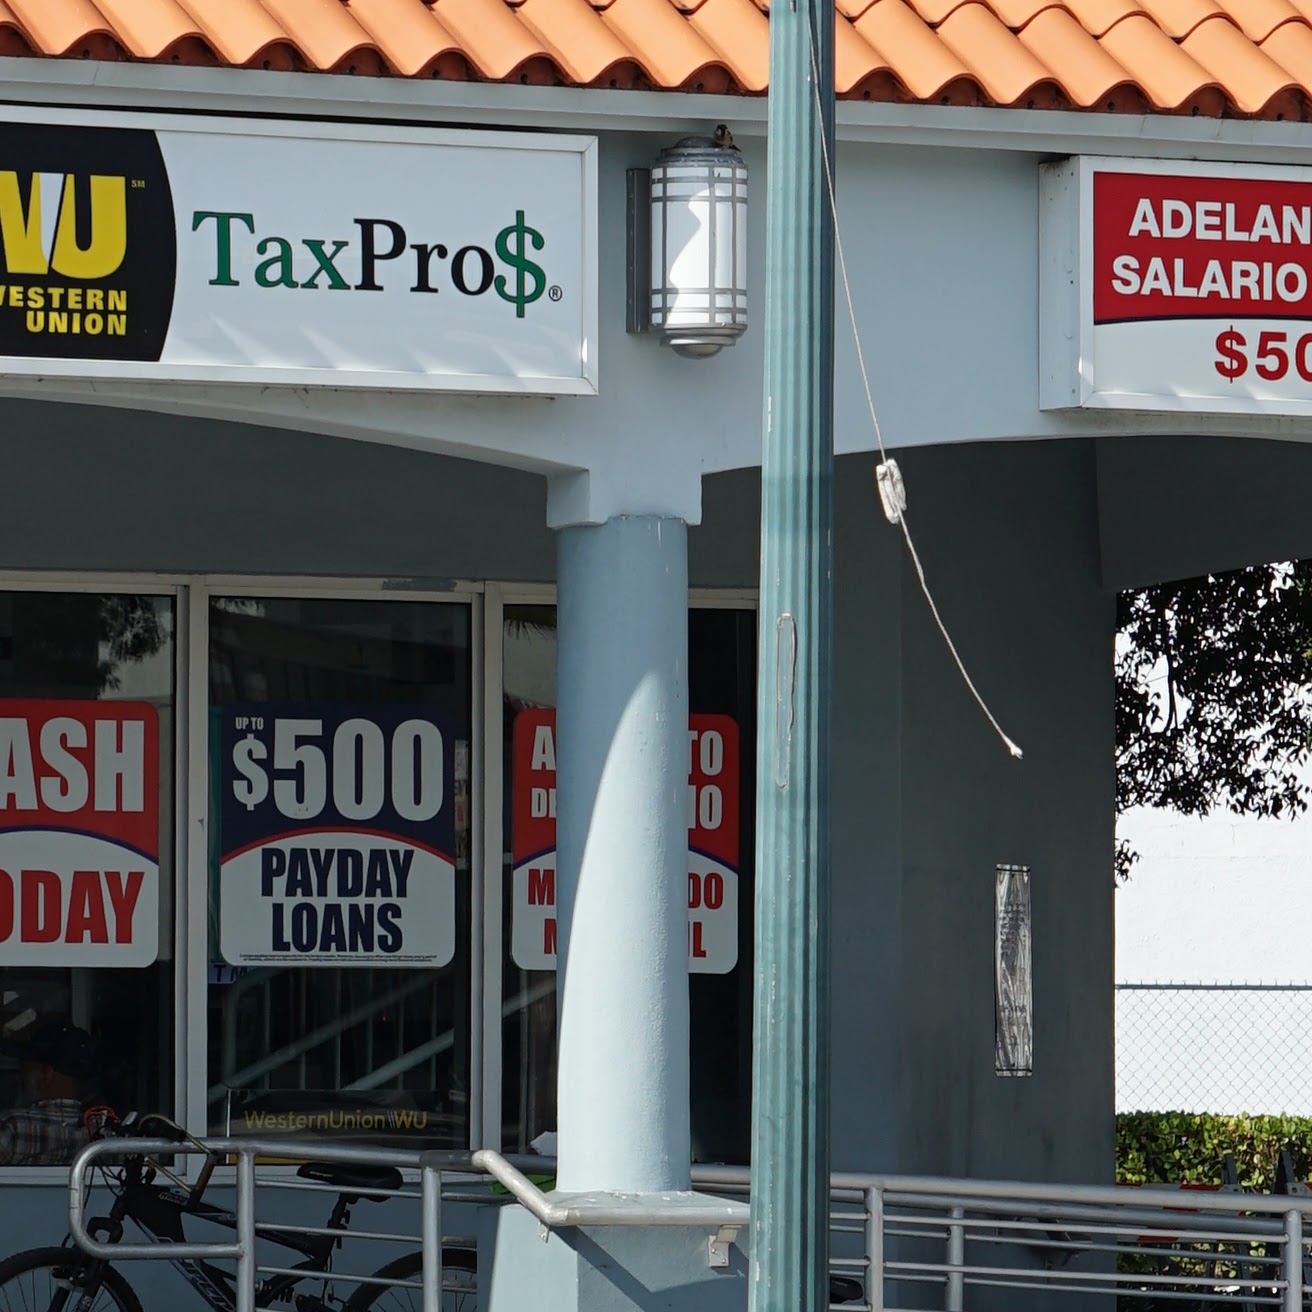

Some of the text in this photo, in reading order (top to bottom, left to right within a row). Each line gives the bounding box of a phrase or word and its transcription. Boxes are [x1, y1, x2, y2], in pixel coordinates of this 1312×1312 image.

[1128, 198, 1312, 245] ADELAN
[1111, 255, 1308, 303] SALARIO
[26, 311, 127, 336] UNION
[235, 717, 264, 730] UP TO
[232, 718, 444, 822] $500
[261, 847, 414, 898] PAYDAY
[272, 902, 403, 953] LOANS
[244, 1109, 386, 1129] WesternUnion
